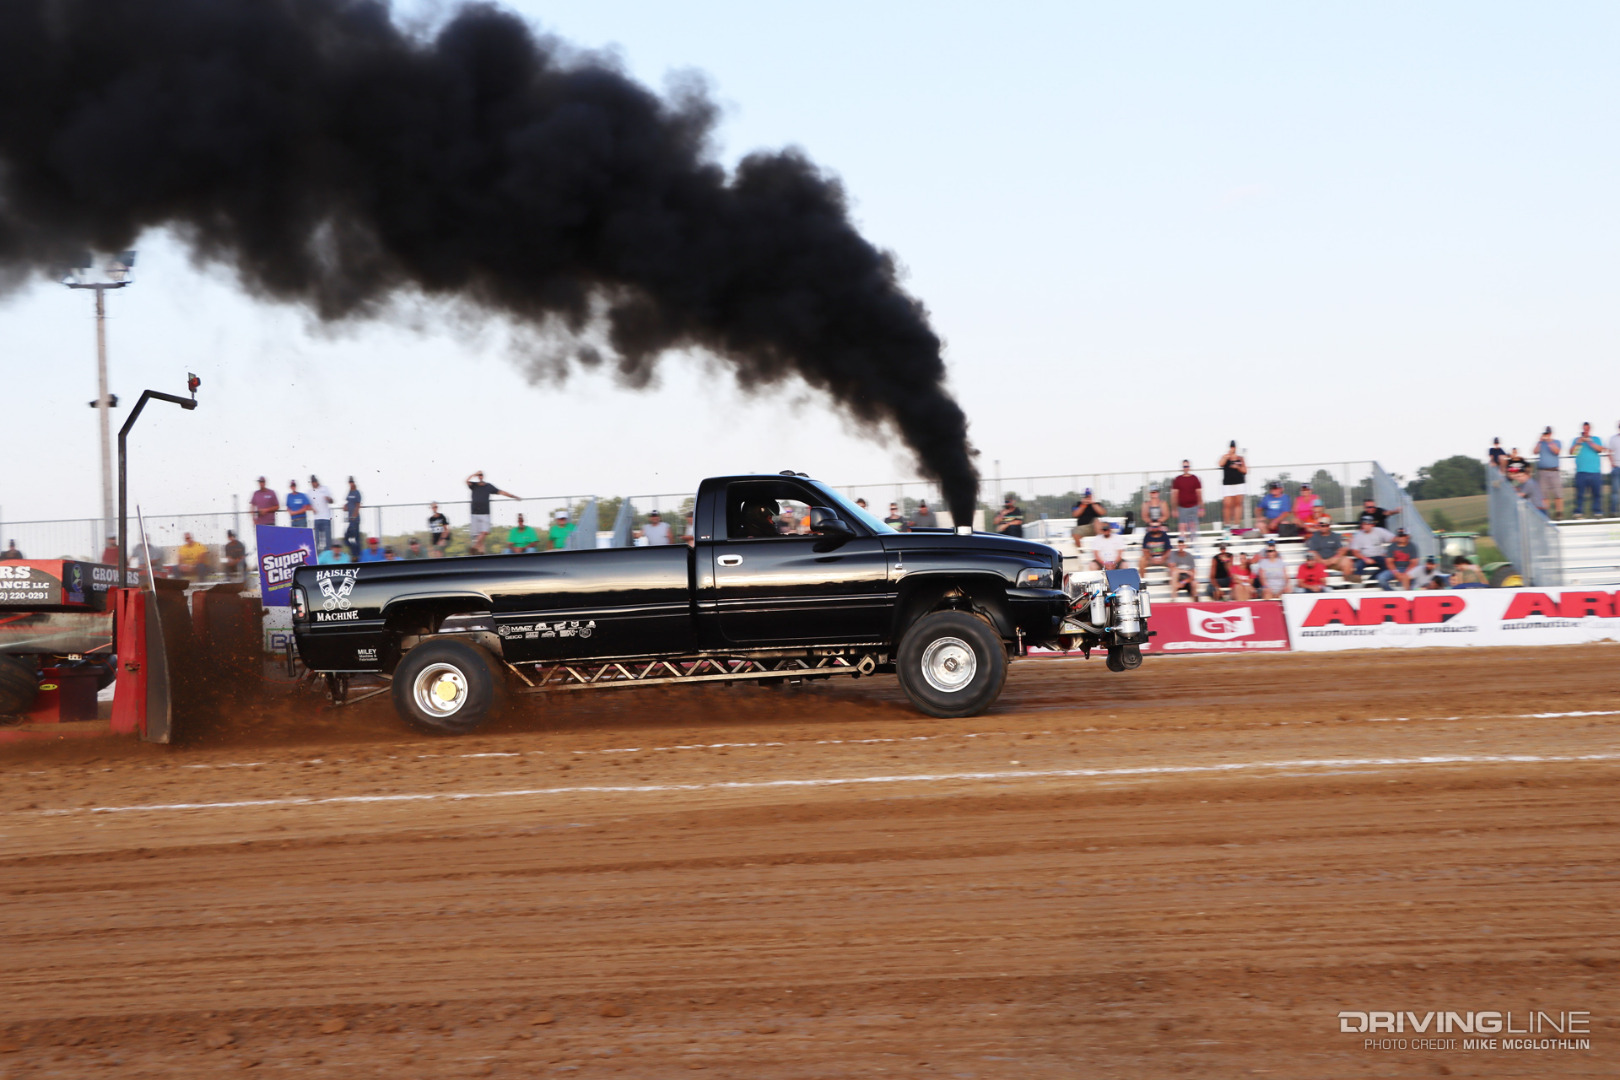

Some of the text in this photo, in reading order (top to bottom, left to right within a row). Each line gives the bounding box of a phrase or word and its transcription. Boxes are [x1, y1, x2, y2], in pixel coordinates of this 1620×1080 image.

[263, 550, 306, 571] Super
[92, 567, 139, 584] GROWRS
[316, 568, 360, 581] HAISLEY
[1301, 596, 1466, 627] ARP
[1502, 590, 1620, 620] AR
[316, 610, 359, 621] MACHINE
